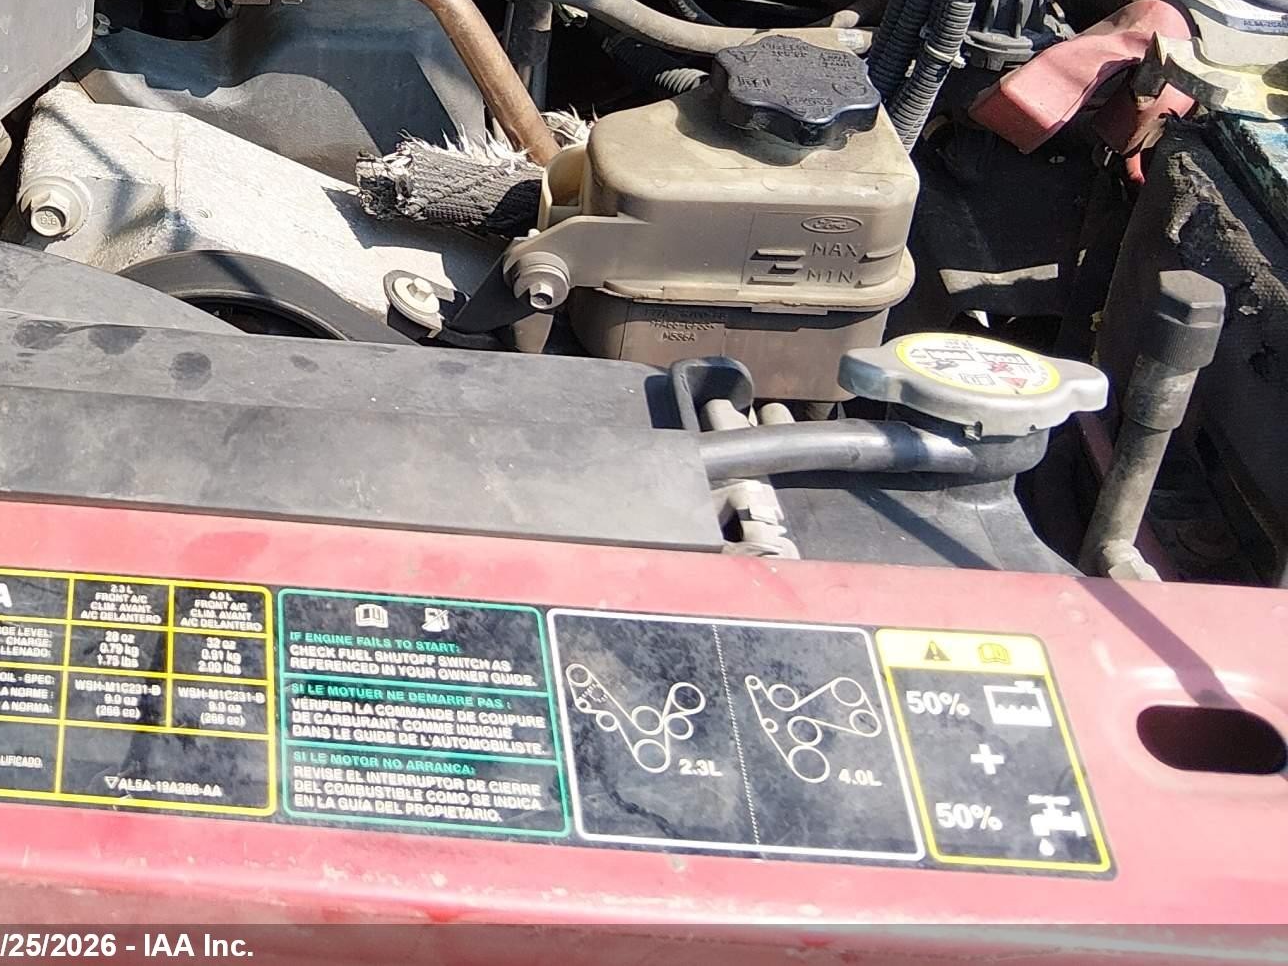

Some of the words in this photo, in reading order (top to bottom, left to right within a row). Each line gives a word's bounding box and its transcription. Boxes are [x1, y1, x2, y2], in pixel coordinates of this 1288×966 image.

[812, 241, 858, 258] MAX
[806, 267, 854, 284] MIN
[95, 593, 129, 601] FRONT
[131, 595, 147, 603] A/C
[195, 600, 228, 609] FRONT
[231, 602, 247, 610] A/C
[81, 611, 98, 619] A/C
[181, 618, 198, 626] A/C
[18, 628, 53, 637] LEVEL:
[290, 631, 302, 640] IF
[305, 633, 351, 644] ENGINE
[357, 636, 390, 647] FAILS
[395, 639, 411, 648] TO
[416, 641, 460, 652] START:
[0, 646, 51, 657] LLENADO:
[125, 644, 139, 657] kg
[227, 651, 241, 663] kg
[290, 645, 335, 657] CHECK
[339, 648, 371, 660] FUEL
[375, 651, 435, 665] SHUTOFF
[438, 656, 490, 669] SWITCH
[491, 660, 511, 670] AS
[0, 672, 16, 681] OIL
[290, 657, 379, 673] REFERENCED
[382, 664, 395, 674] IN
[398, 665, 436, 678] YOUR
[438, 669, 488, 681] OWNER
[491, 673, 536, 685] GUIDE.
[10, 687, 48, 698] NORME
[291, 683, 304, 694] SI
[308, 685, 323, 694] LE
[328, 686, 382, 698] MOTUER
[387, 691, 403, 700] NE
[477, 698, 503, 707] PAS
[905, 689, 971, 718] 50%
[292, 711, 310, 723] DE
[403, 720, 454, 733] COMME
[355, 702, 373, 714] LA
[375, 705, 454, 720] COMMANDE
[457, 711, 476, 722] DE
[479, 713, 545, 727] COUPURE
[293, 725, 330, 738] DANS
[333, 727, 350, 739] LE
[354, 730, 395, 742] GUIDE
[399, 733, 417, 744] DE
[293, 751, 306, 762] SI
[311, 753, 326, 763] LE
[331, 754, 378, 766] MOTOR
[383, 757, 401, 768] NO
[406, 760, 474, 774] ARRANCA:
[678, 758, 723, 778] 2.3L
[294, 766, 342, 780] REVISE
[346, 770, 365, 781] EL
[367, 772, 464, 789] INTERRUPTOR
[466, 779, 486, 790] DE
[489, 781, 540, 795] CIERRE
[838, 767, 883, 788] 4.0L
[295, 780, 320, 793] DEL
[324, 782, 422, 800] COMBUSTIBLE
[426, 790, 469, 804] COMO
[472, 794, 490, 805] SE
[295, 794, 313, 807] EN
[317, 796, 335, 808] LA
[375, 799, 401, 813] DEL
[405, 803, 502, 821] PROPIETARIO.
[934, 802, 1003, 831] 50%
